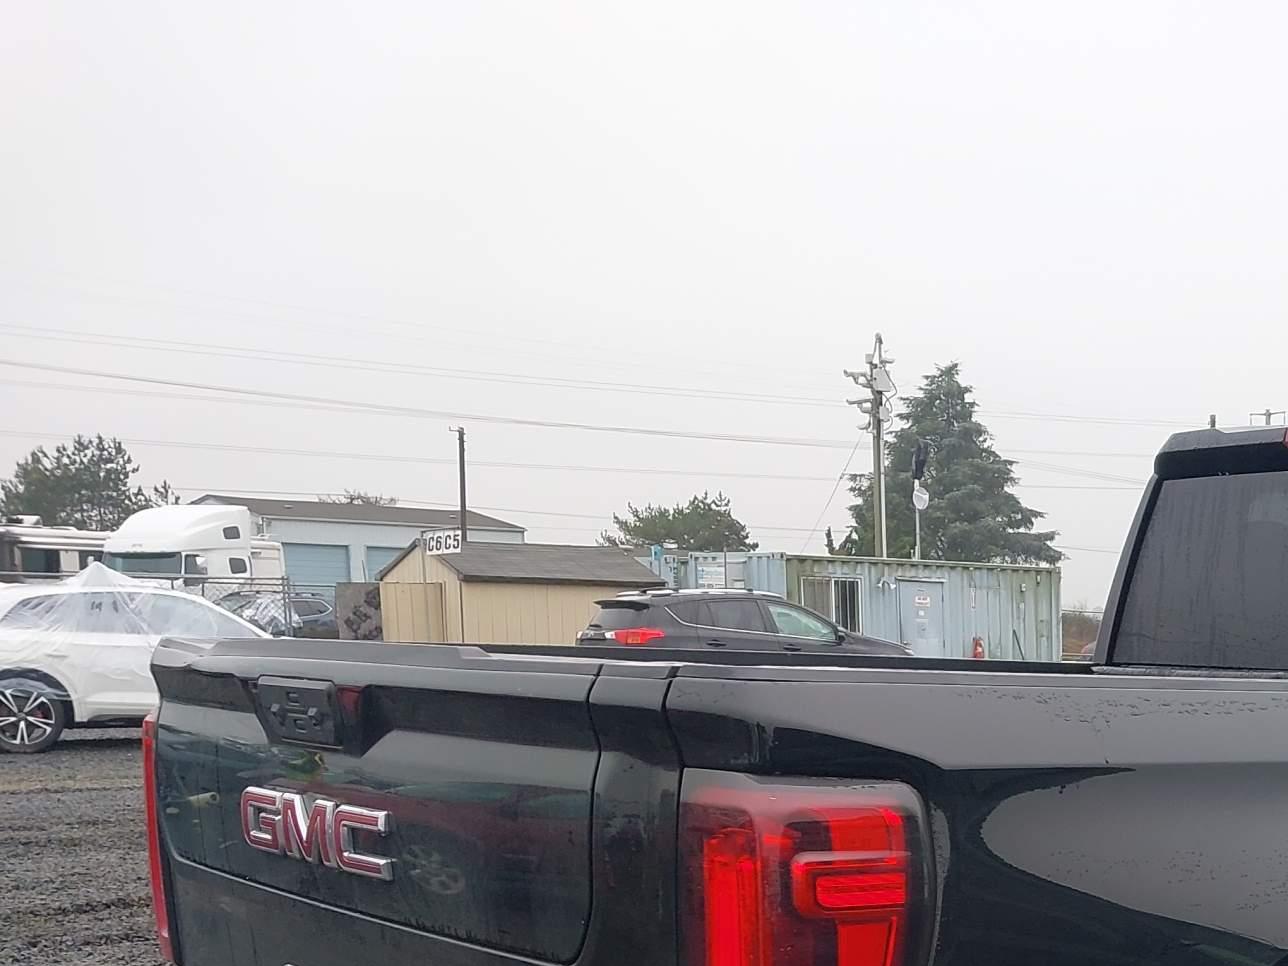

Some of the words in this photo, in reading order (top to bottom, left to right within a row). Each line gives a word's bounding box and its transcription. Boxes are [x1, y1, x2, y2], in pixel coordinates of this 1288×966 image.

[428, 536, 443, 552] C6
[444, 534, 460, 550] C5
[240, 786, 395, 881] GMC
